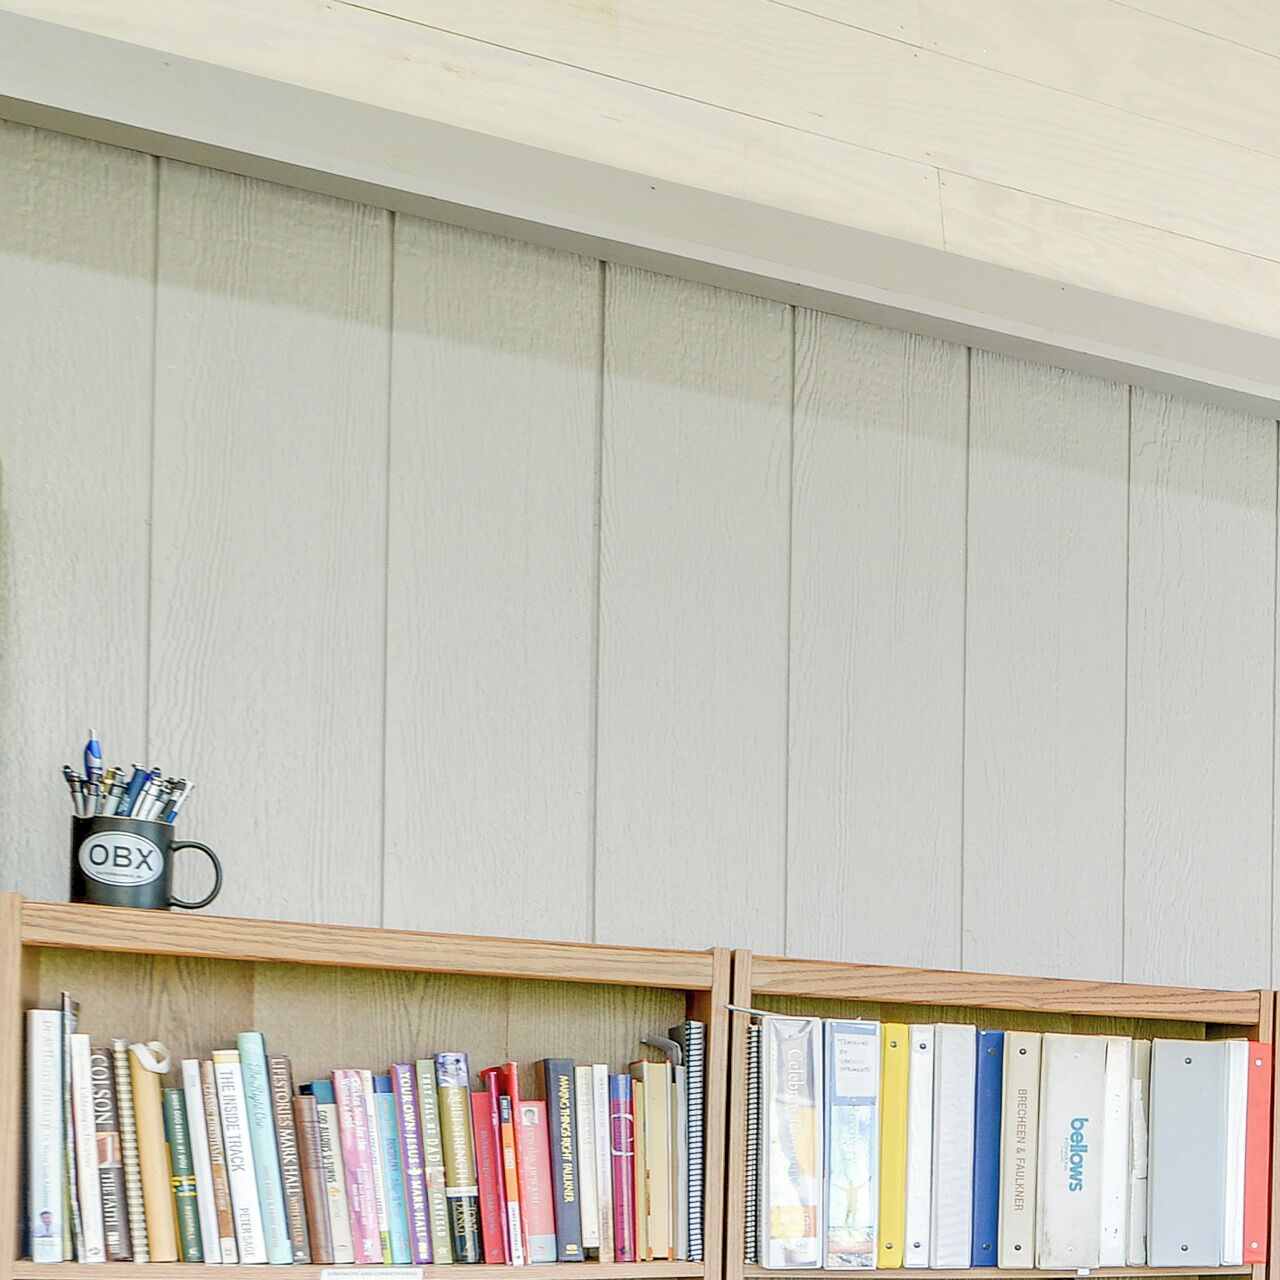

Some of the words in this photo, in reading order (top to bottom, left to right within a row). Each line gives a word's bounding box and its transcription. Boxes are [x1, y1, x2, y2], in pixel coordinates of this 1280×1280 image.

[90, 844, 154, 871] OBX
[90, 1054, 114, 1126] COLSON
[220, 1070, 235, 1091] THE
[399, 1071, 414, 1102] YOUR
[558, 1075, 571, 1108] MAKING
[222, 1094, 240, 1131] INSIDE
[402, 1104, 417, 1130] OWN
[560, 1108, 573, 1137] THINGS
[1016, 1089, 1028, 1143] BRECHEEN
[227, 1134, 245, 1172] TRACK
[404, 1132, 419, 1164] JESUS
[561, 1137, 574, 1161] RIGHT
[1069, 1118, 1089, 1192] bellows
[101, 1172, 115, 1193] THE
[409, 1181, 423, 1209] MARK
[562, 1163, 575, 1202] FAULKNER
[1014, 1158, 1025, 1211] FAULKNER
[103, 1196, 119, 1225] FAITH
[238, 1208, 251, 1233] PETER
[412, 1212, 427, 1237] HALL
[432, 1193, 446, 1237] CANFIELD
[466, 1206, 479, 1232] TONY
[242, 1236, 255, 1258] SAGE
